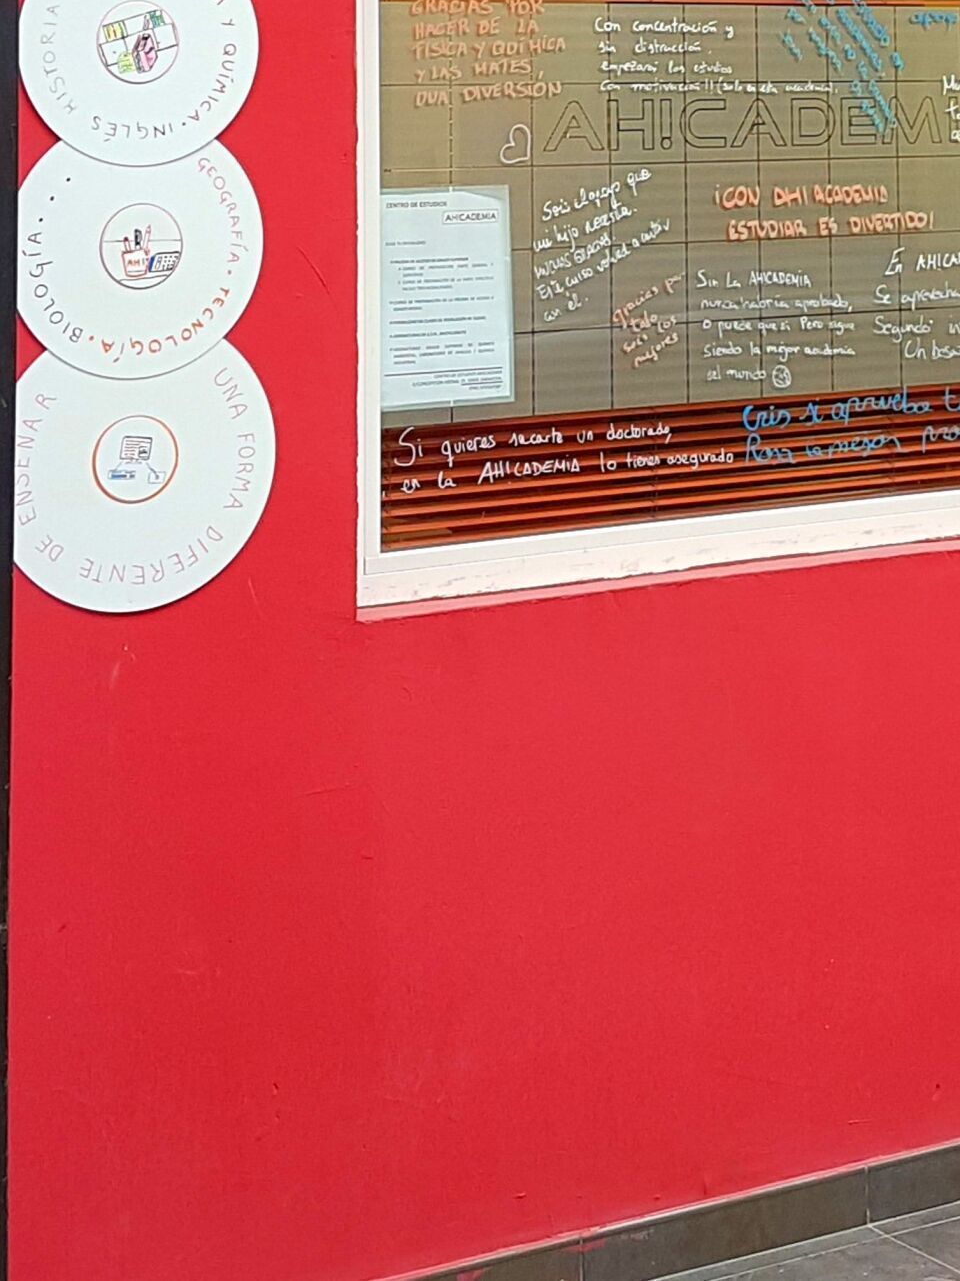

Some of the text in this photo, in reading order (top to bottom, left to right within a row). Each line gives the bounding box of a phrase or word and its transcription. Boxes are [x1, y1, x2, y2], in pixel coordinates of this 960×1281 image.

[413, 20, 470, 41] HACER
[594, 17, 735, 40] Con concentración y
[39, 3, 78, 115] HISTORIA
[187, 42, 238, 122] QUÍMICA
[90, 115, 174, 143] INGLÉS
[197, 156, 250, 264] GEOGRAFÍA
[727, 218, 808, 242] ESTUDIAR
[819, 217, 839, 237] ES
[696, 269, 719, 288] Sin
[884, 247, 906, 276] En
[21, 230, 85, 344] BIOLOGÍA
[873, 284, 892, 305] Se
[100, 285, 231, 363] TECNOLOGÍA
[750, 340, 761, 356] la
[903, 339, 927, 362] Un
[213, 366, 249, 420] UNA
[393, 425, 424, 467] Si
[440, 433, 497, 468] quieres
[576, 429, 594, 443] un
[222, 432, 256, 511] FORMA
[401, 479, 420, 494] en
[437, 470, 457, 489] la
[600, 451, 617, 472] lo
[666, 451, 735, 471] asegurado
[34, 533, 65, 563] DE
[78, 525, 224, 586] DIFERENTE
